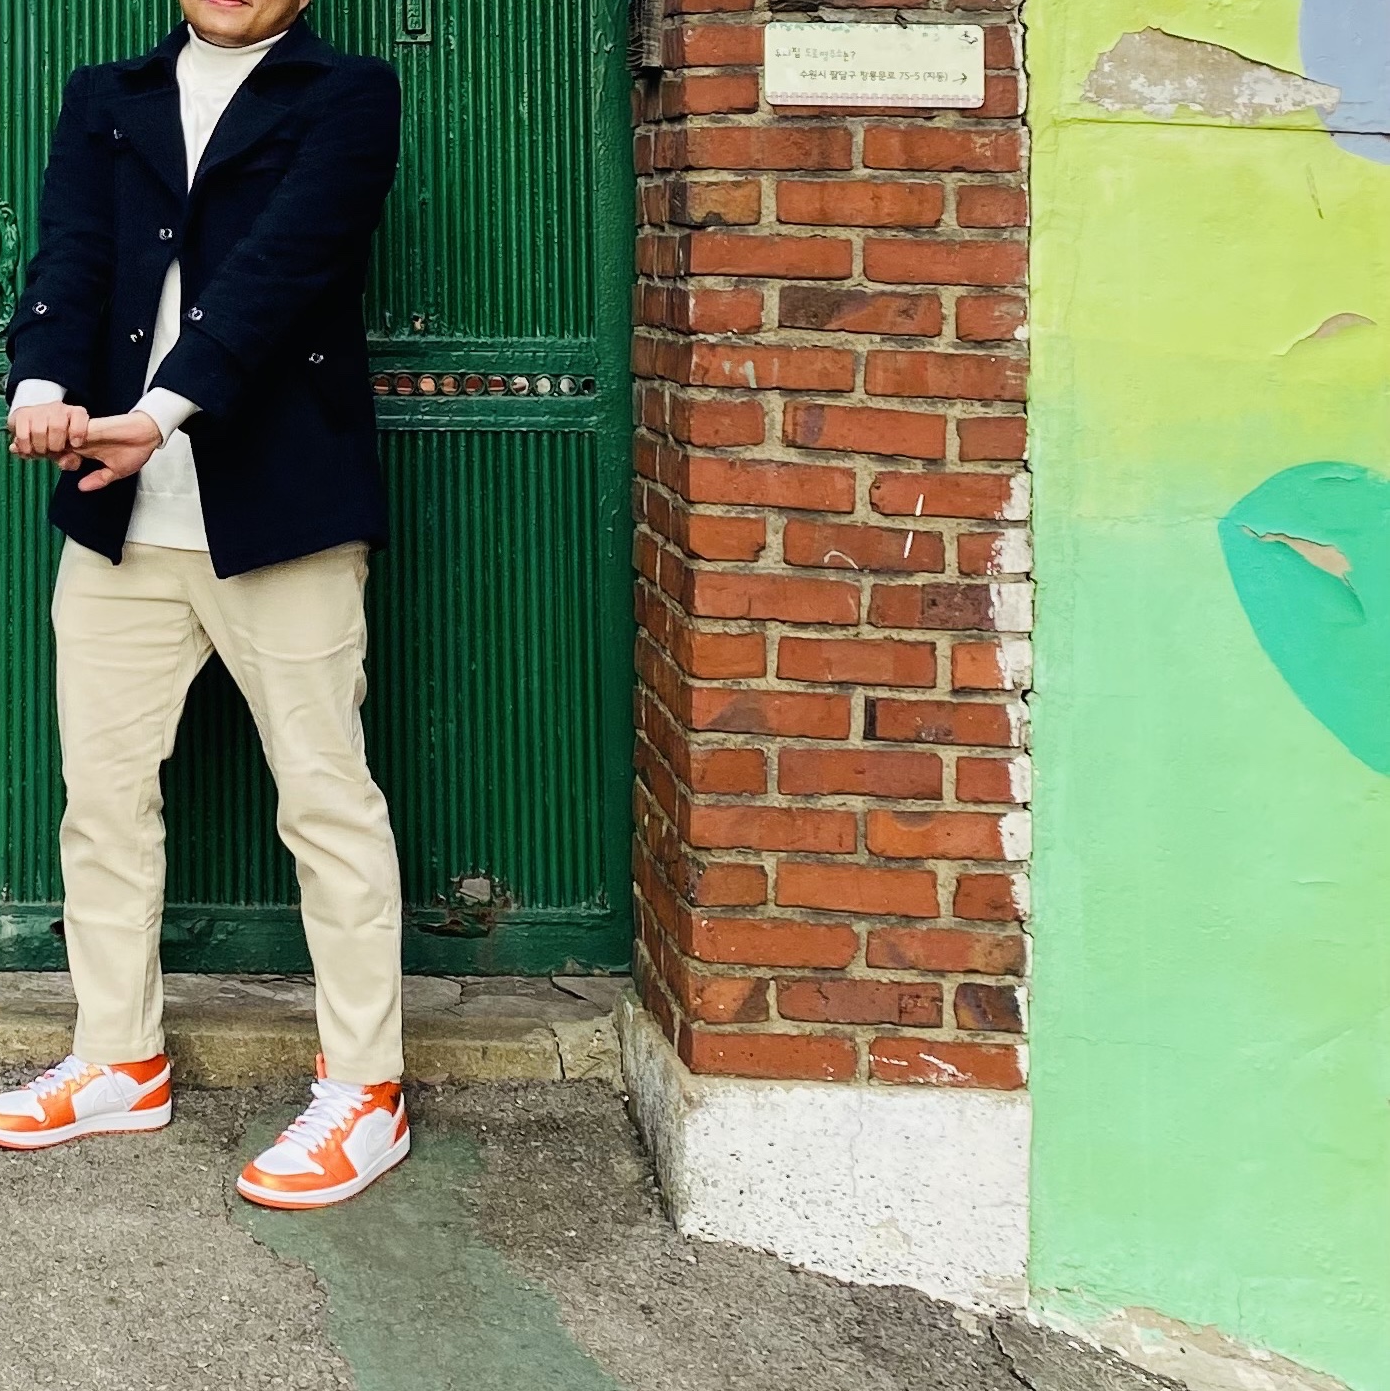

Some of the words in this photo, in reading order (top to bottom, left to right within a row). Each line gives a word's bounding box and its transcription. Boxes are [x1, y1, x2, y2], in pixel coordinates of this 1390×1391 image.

[799, 70, 826, 81] 수원시
[830, 70, 856, 81] 팔달구
[860, 70, 896, 82] 창룡문로
[899, 71, 920, 81] 75-5
